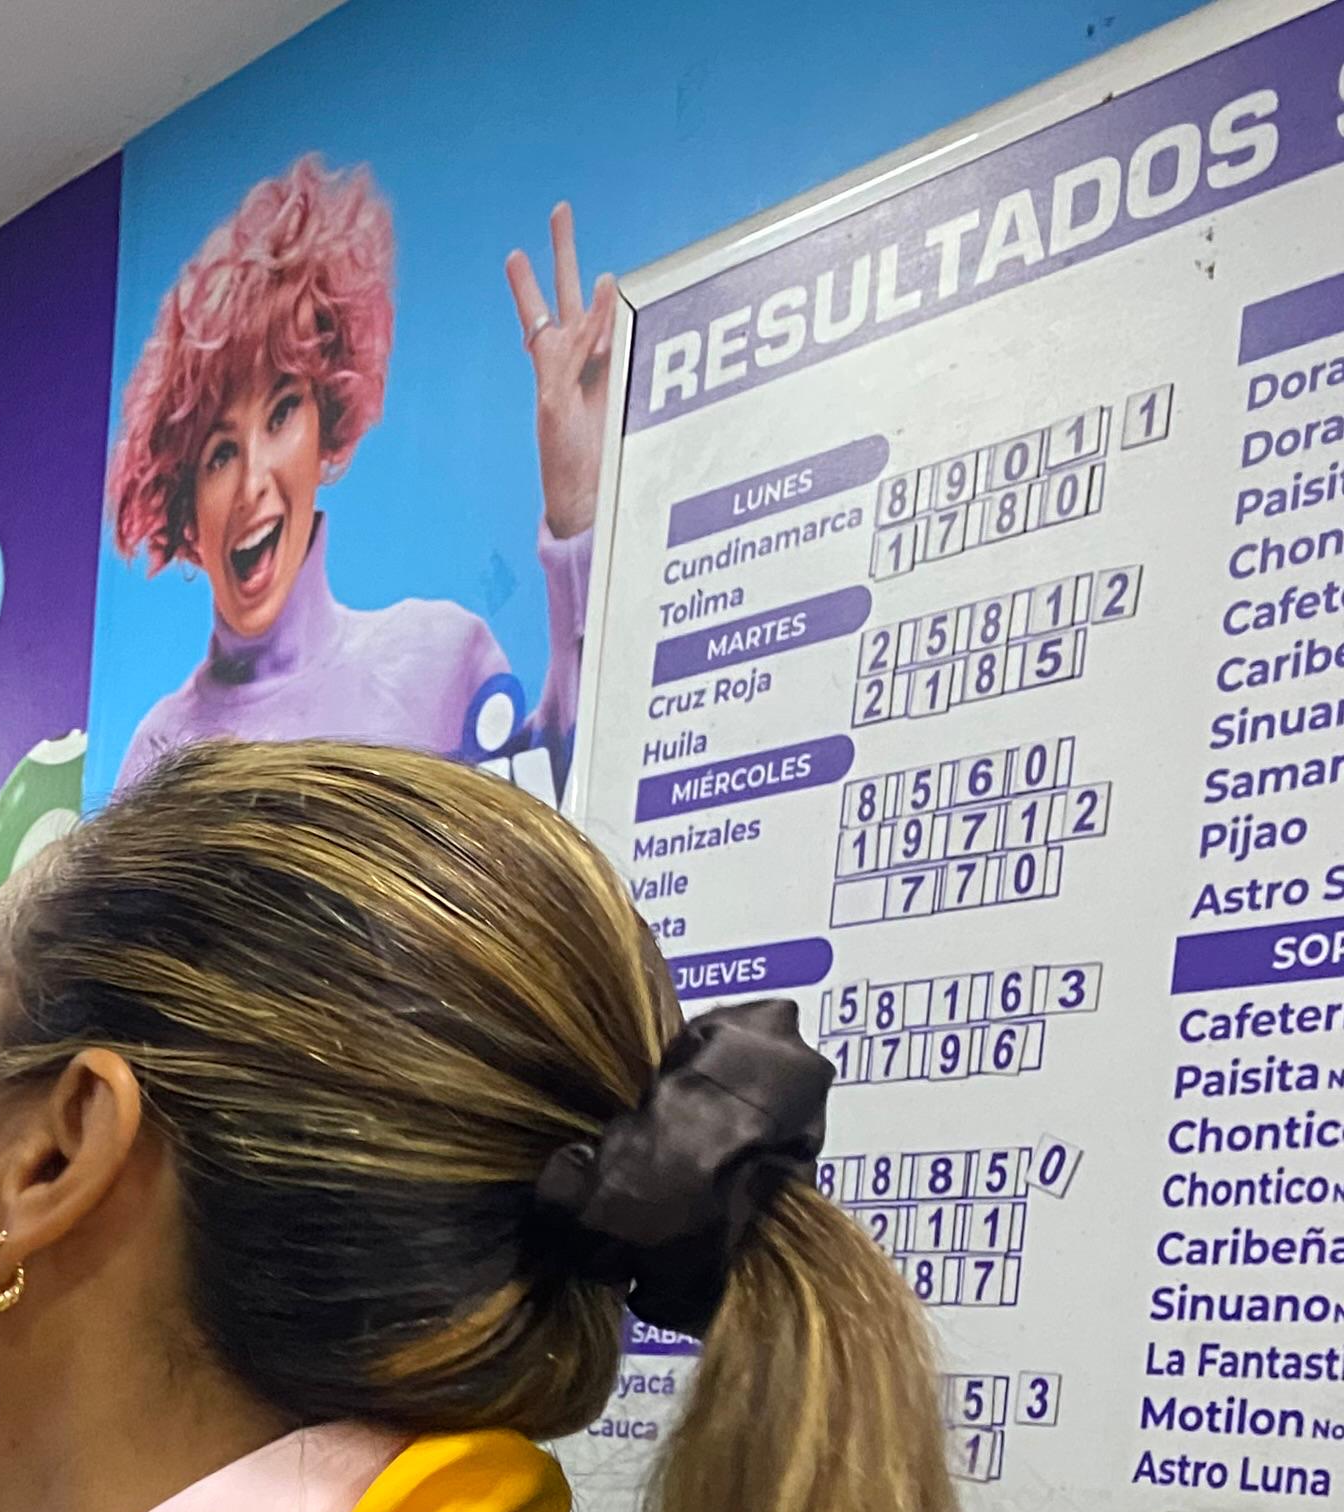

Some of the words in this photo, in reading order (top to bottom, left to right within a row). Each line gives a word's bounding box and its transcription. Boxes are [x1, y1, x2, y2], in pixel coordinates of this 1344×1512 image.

[648, 89, 1279, 413] RESULTADOS
[732, 468, 813, 516] LUNES
[1236, 461, 1344, 525] Paisi
[663, 506, 863, 586] Cundinamarca
[1223, 581, 1344, 636] Cafet
[707, 614, 806, 661] MARTES
[648, 688, 707, 720] Cruz
[714, 672, 772, 705] Roja
[643, 731, 708, 766] Huila
[670, 753, 812, 805] MIÉRCOLES
[633, 818, 762, 862] Manizales
[1200, 813, 1307, 862] Pijao
[630, 871, 689, 902] Valle
[1190, 878, 1309, 920] Astro
[650, 917, 687, 940] eta
[676, 957, 767, 990] JUEVES
[1175, 1056, 1318, 1100] Paisita
[1168, 1110, 1344, 1155] Chontic
[1162, 1166, 1328, 1209] Chontico
[1150, 1287, 1330, 1324] Sinuano
[1146, 1342, 1189, 1377] La
[1140, 1395, 1305, 1438] Motilon
[1133, 1450, 1228, 1490] Astro
[1241, 1457, 1330, 1497] Luna
